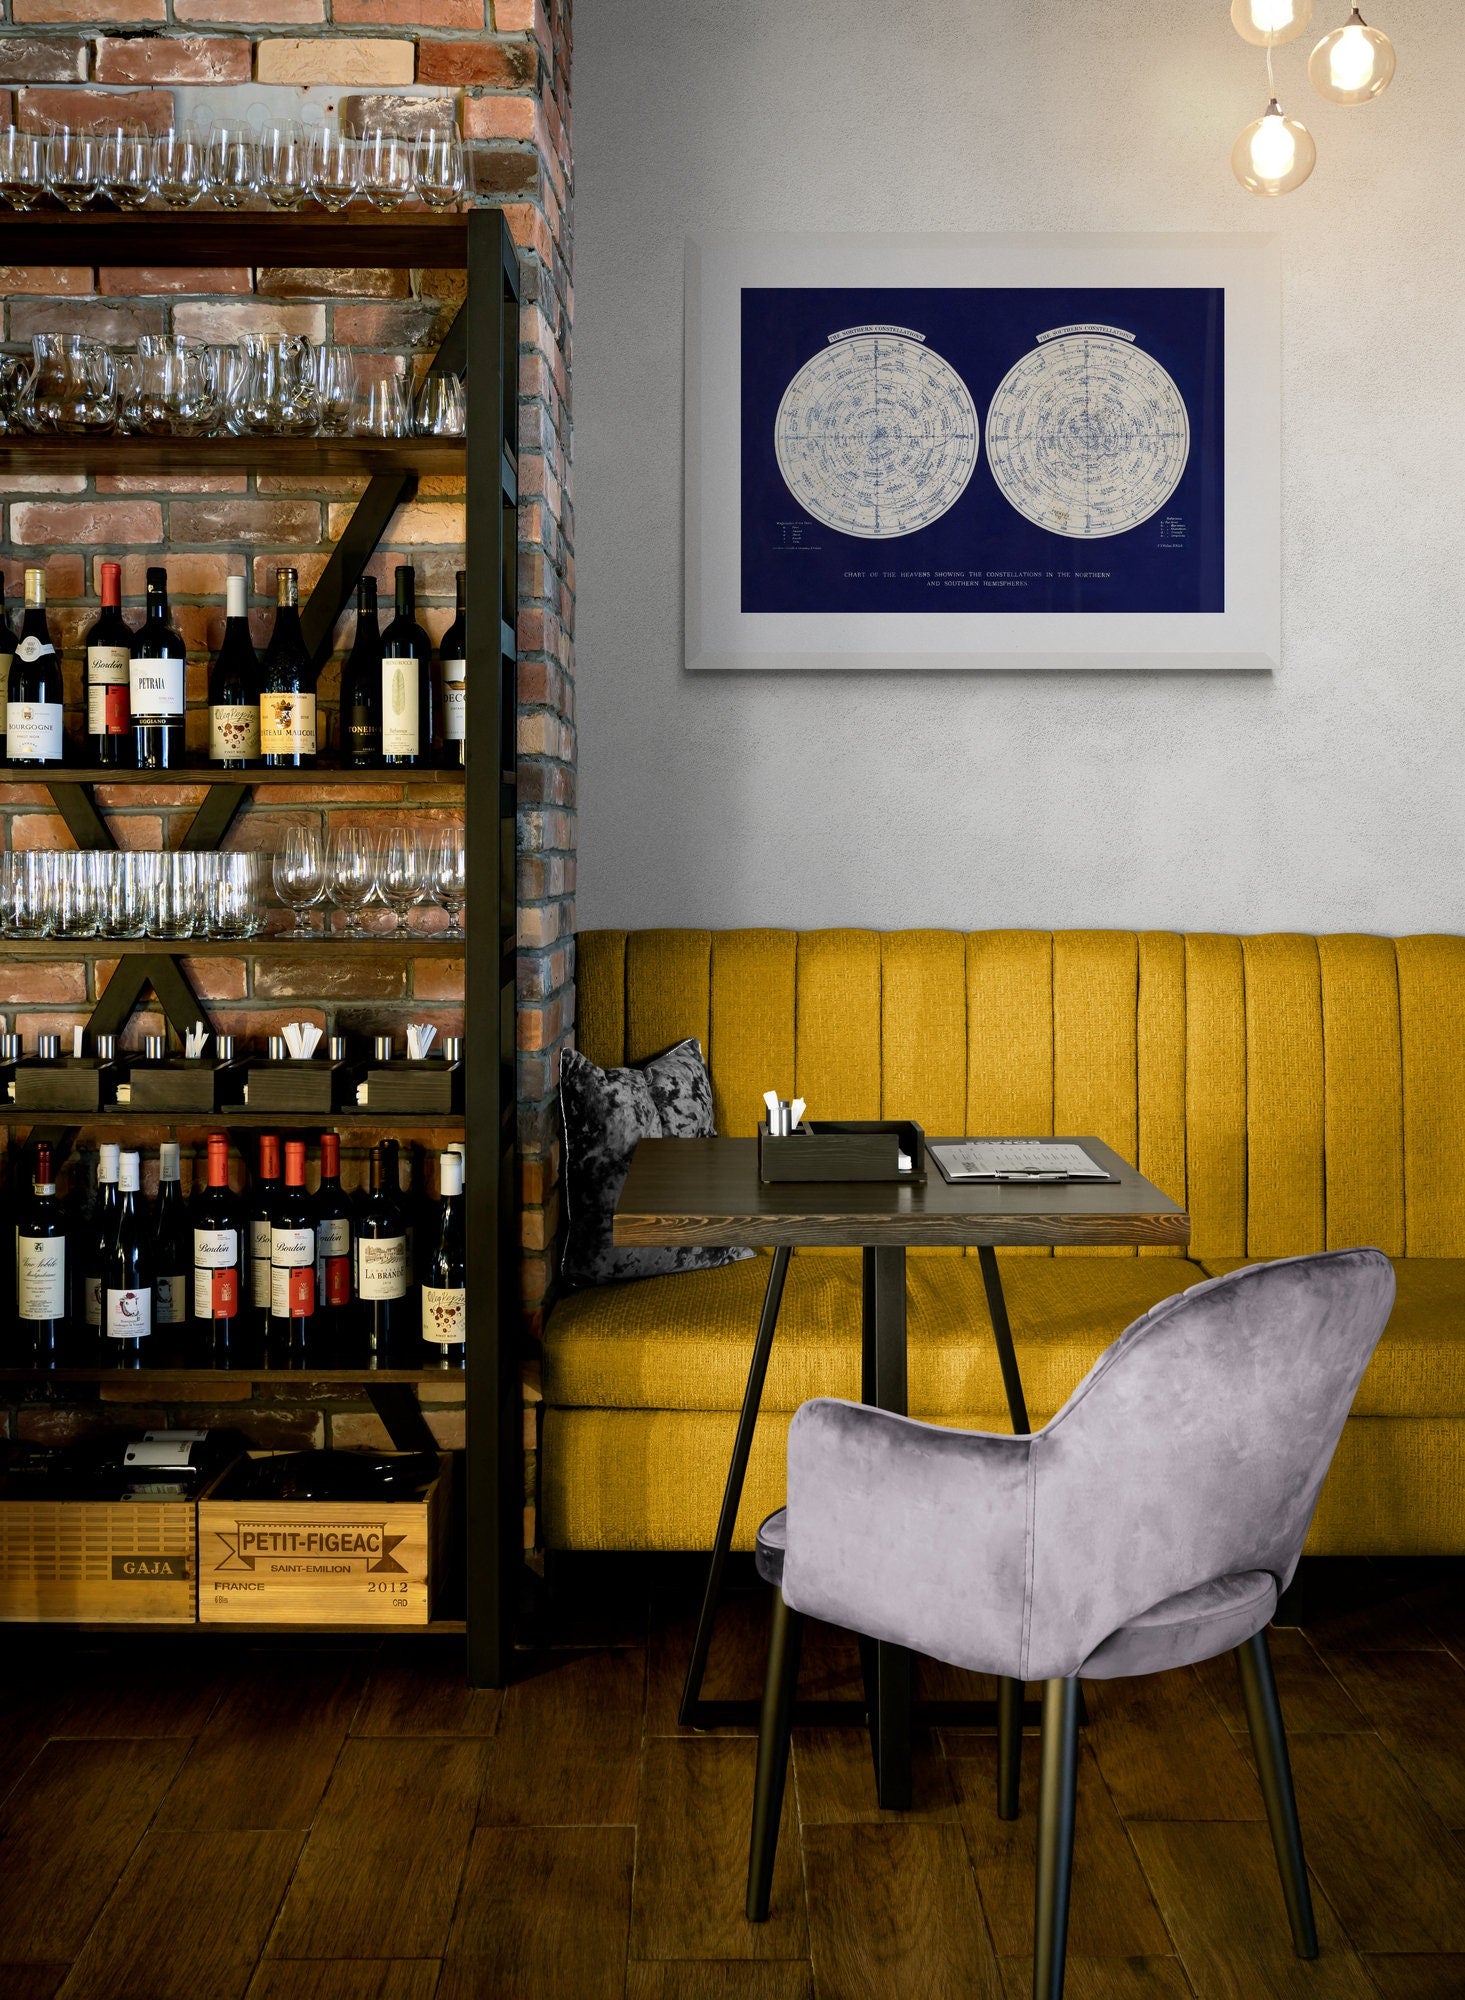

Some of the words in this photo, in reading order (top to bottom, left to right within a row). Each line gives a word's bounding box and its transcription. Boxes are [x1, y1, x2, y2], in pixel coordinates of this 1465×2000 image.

[829, 334, 841, 342] THE
[842, 327, 873, 336] NORTHERN
[874, 326, 924, 340] CONSTELLATIONS
[1039, 334, 1050, 342] THE
[1052, 326, 1083, 336] SOUTHERN
[92, 659, 123, 670] Bordón
[138, 677, 165, 690] PETRAIA
[443, 693, 466, 703] DEC
[9, 723, 53, 731] BOURGOGNE
[199, 1242, 229, 1253] Bordón
[276, 1242, 306, 1253] Bordón
[243, 1532, 380, 1553] PETIT-FIGEAC
[123, 1561, 174, 1575] GAJA
[270, 1564, 351, 1573] SAINT-EMILION
[214, 1582, 265, 1591] FRANCE
[367, 1581, 408, 1593] 2012
[392, 1599, 408, 1607] CRD
